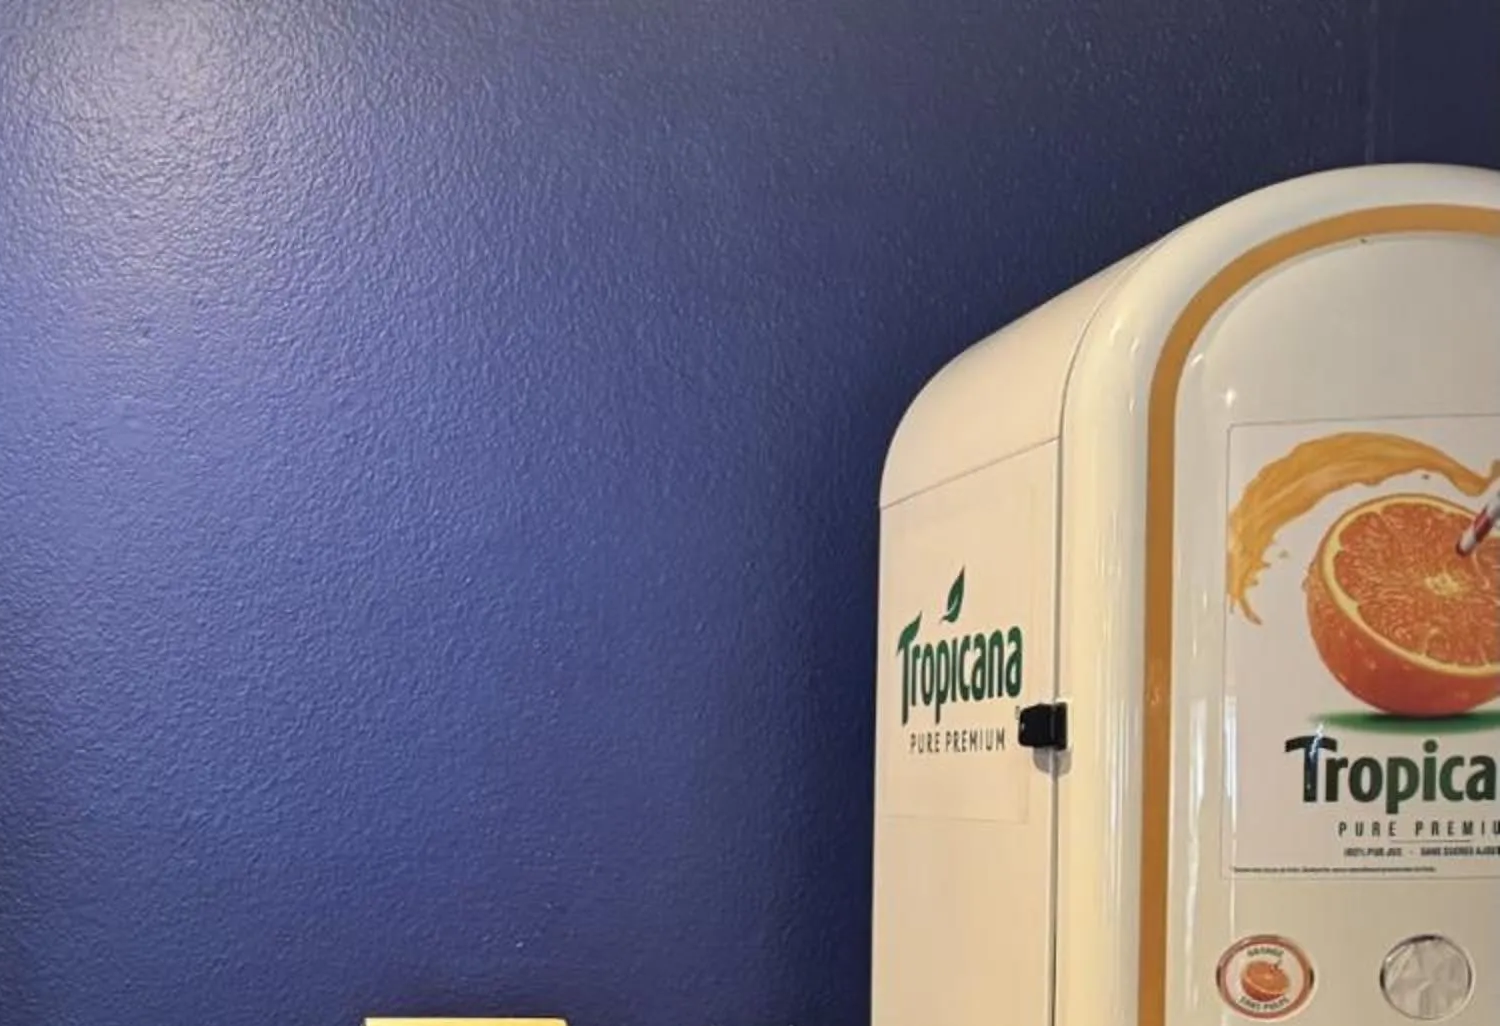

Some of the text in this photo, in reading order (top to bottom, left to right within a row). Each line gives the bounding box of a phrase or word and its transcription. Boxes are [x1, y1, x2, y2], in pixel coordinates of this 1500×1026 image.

[897, 610, 1023, 727] Tropicana
[909, 728, 1005, 754] PURE PREMIUM
[1338, 821, 1396, 837] PURE
